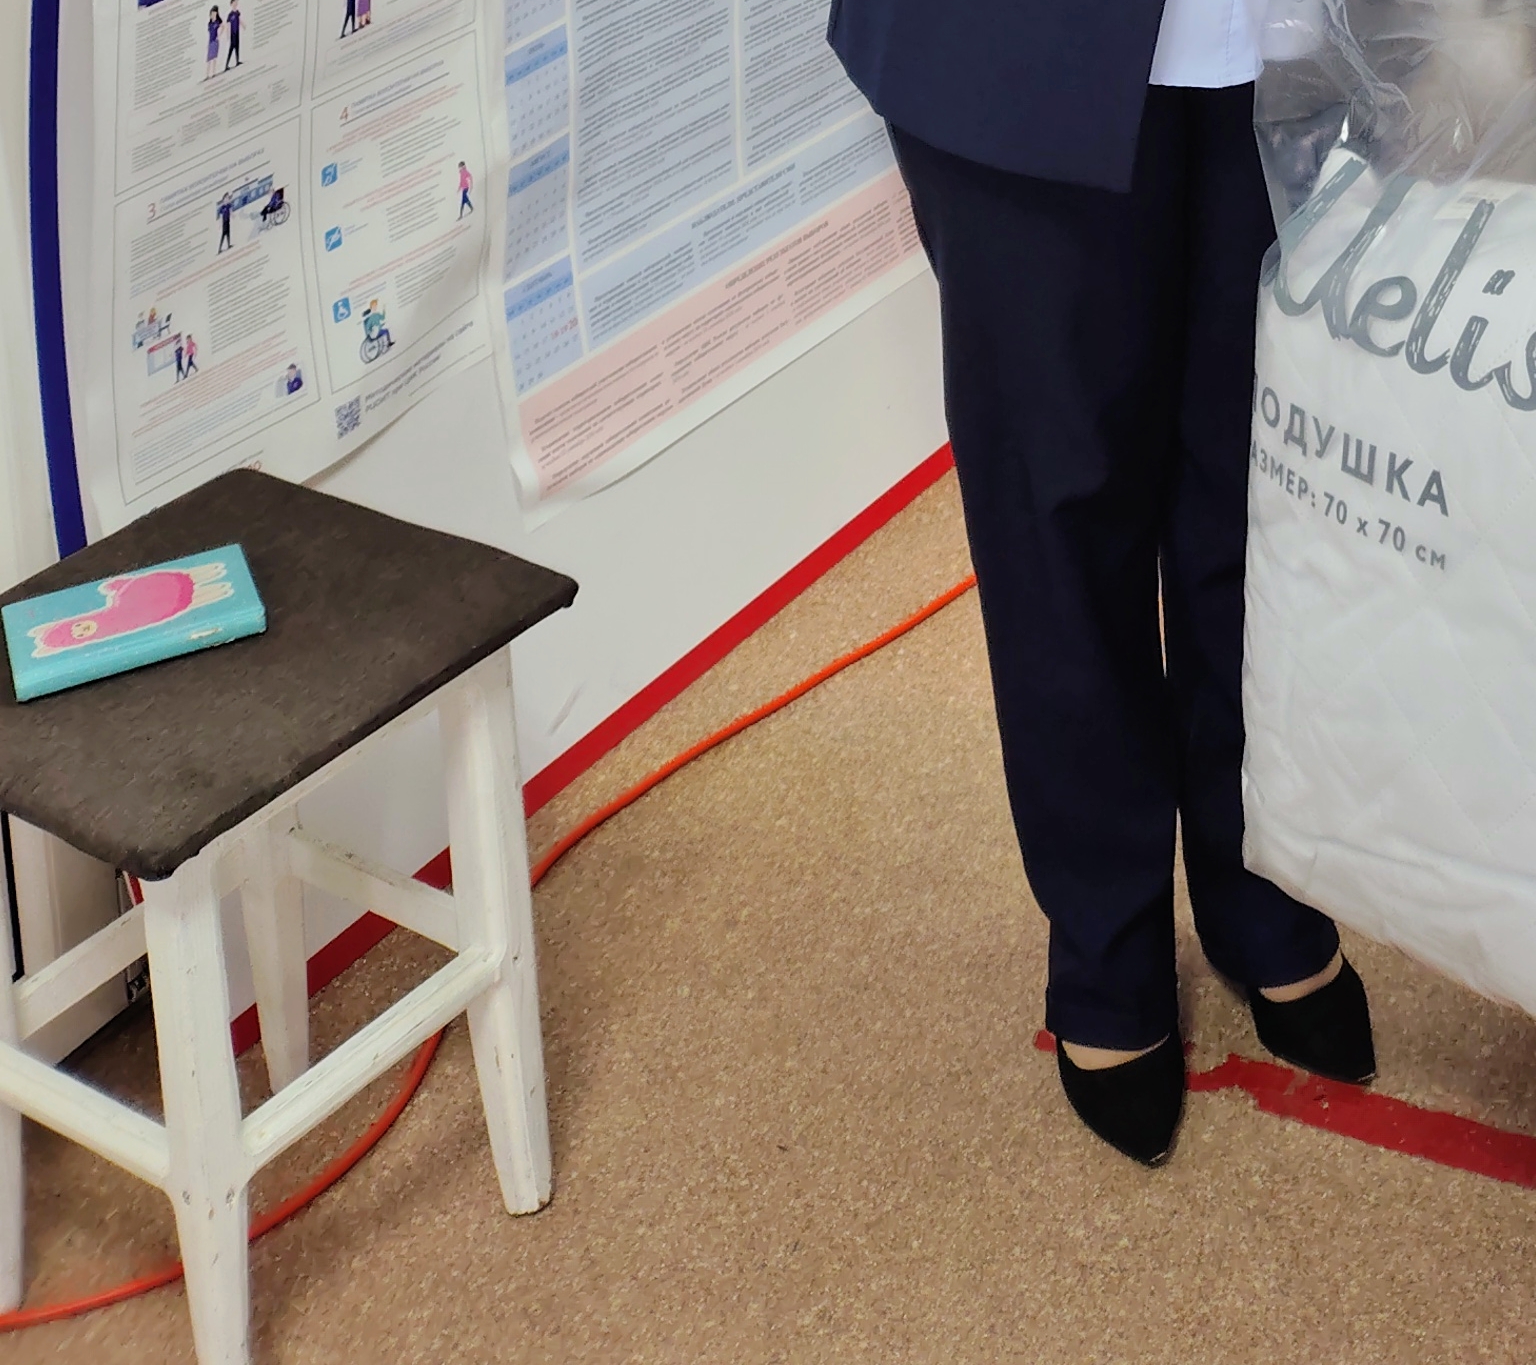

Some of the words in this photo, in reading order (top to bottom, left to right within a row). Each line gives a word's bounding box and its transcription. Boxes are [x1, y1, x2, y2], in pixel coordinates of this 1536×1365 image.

[340, 106, 348, 121] 4
[148, 202, 156, 219] 3
[1253, 373, 1449, 518] ОДУШКА
[1324, 491, 1348, 525] 70
[1378, 518, 1406, 553] 70
[1415, 544, 1446, 570] см
